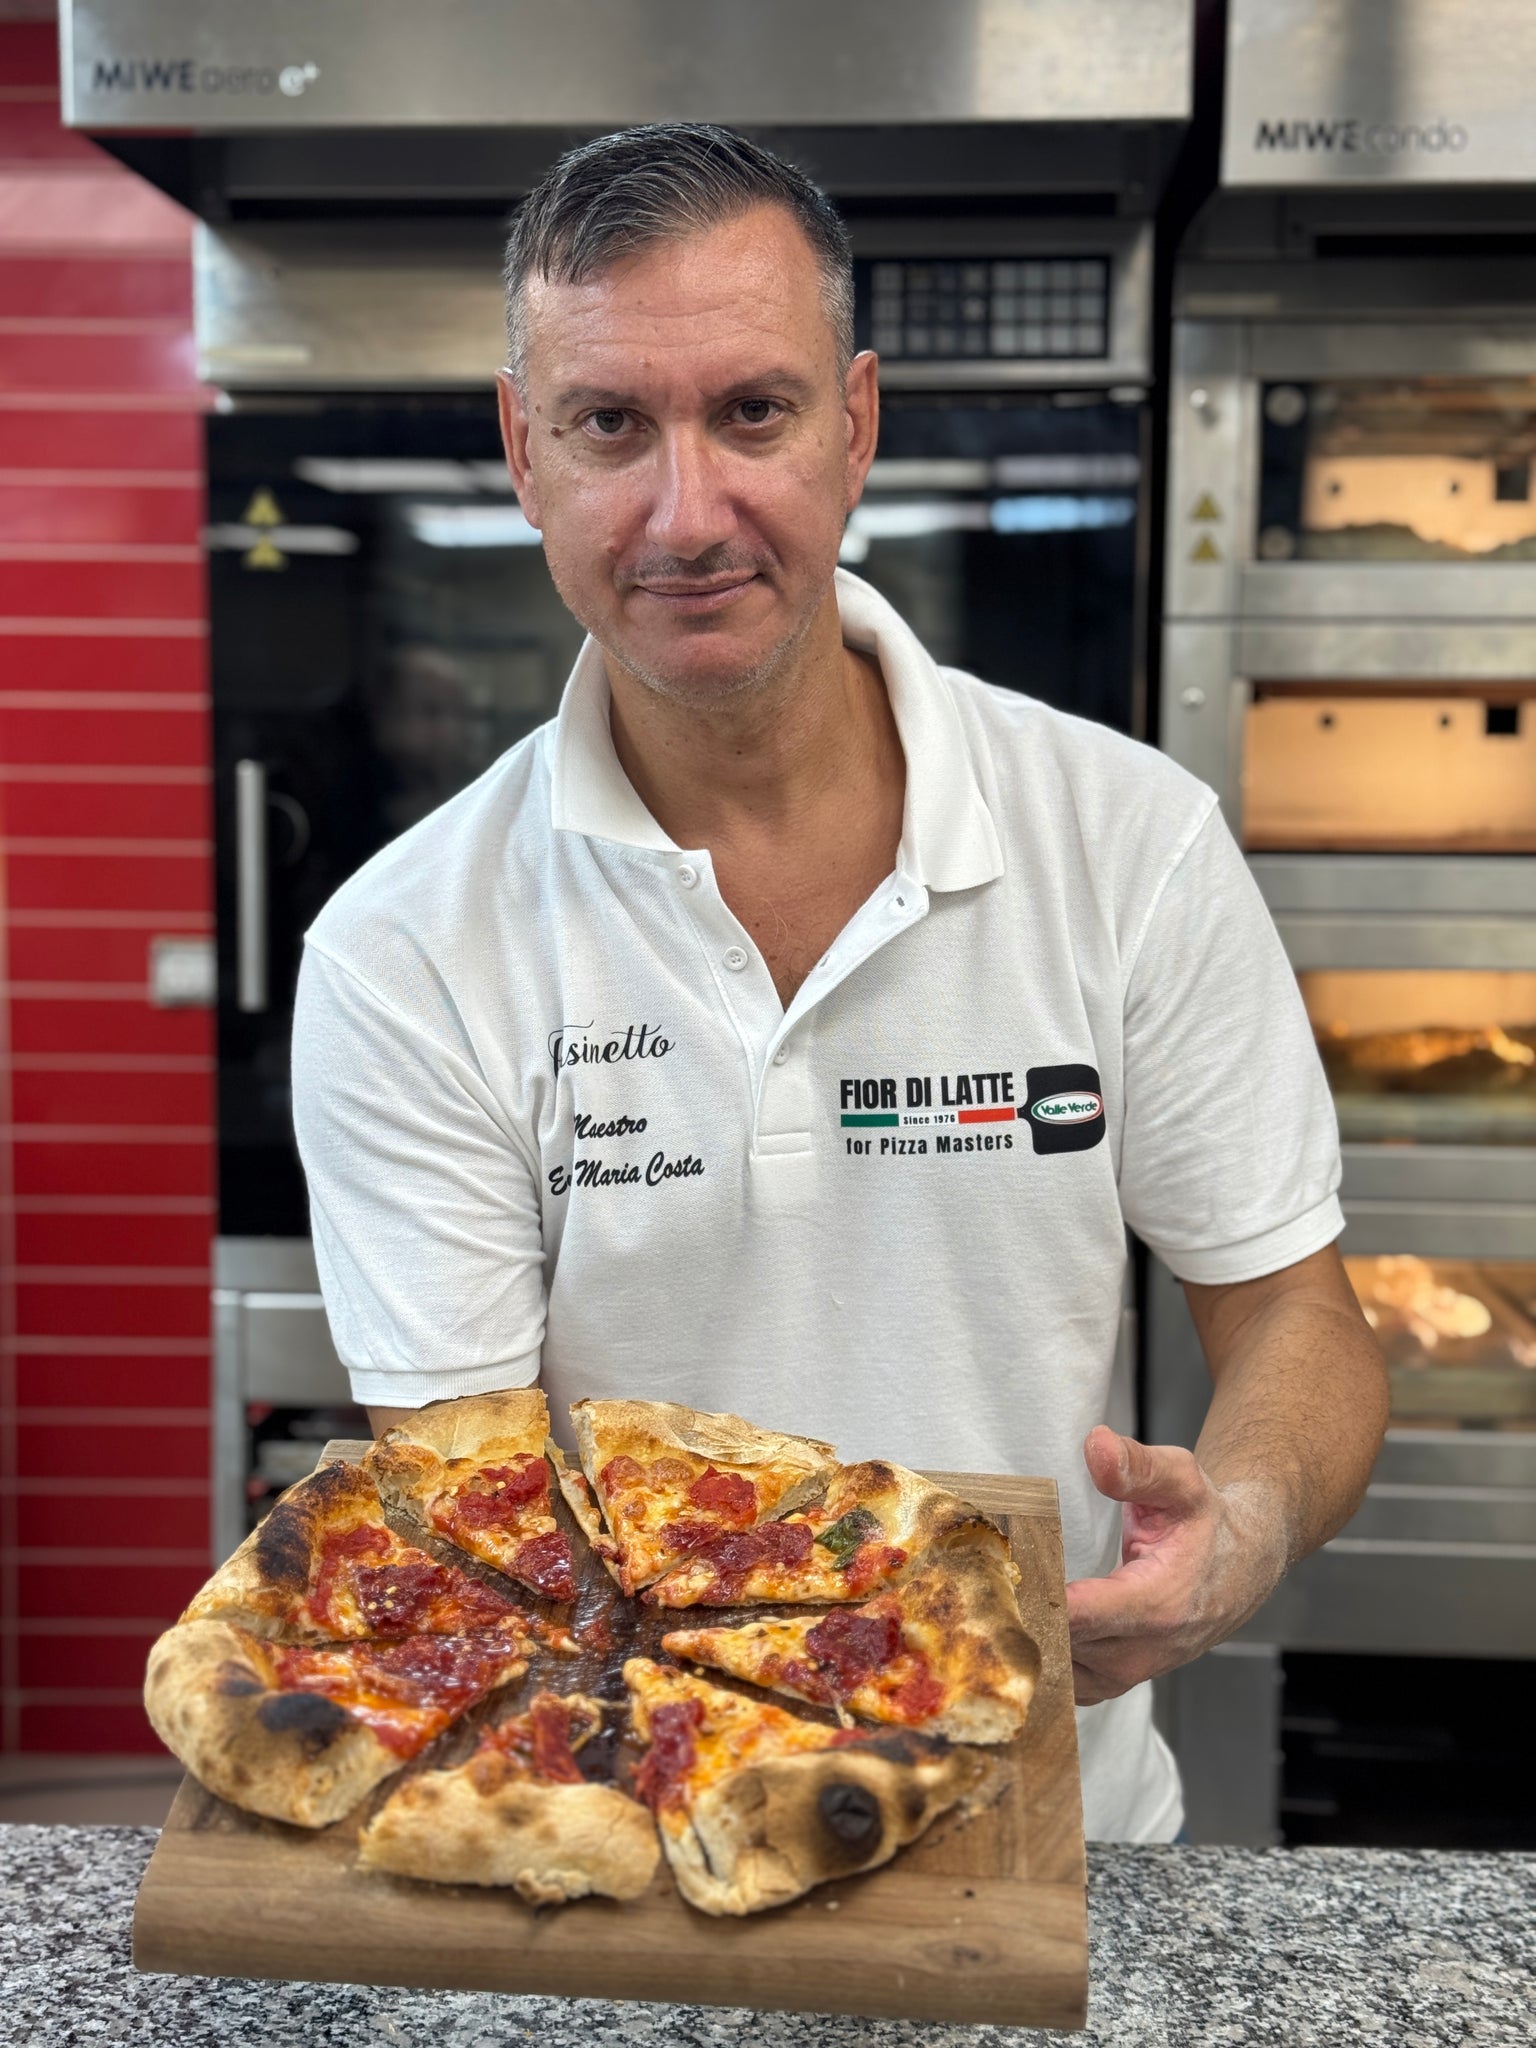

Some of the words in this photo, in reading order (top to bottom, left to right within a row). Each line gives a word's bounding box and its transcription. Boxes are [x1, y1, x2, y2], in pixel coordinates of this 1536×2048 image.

[93, 60, 196, 93] MIWE
[1254, 120, 1358, 151] MIWE
[1363, 118, 1469, 153] condo
[839, 1078, 897, 1110] FIOR
[905, 1076, 932, 1107] DI
[940, 1071, 1015, 1106] LATTE
[903, 1115, 930, 1125] Since
[934, 1113, 956, 1124] 1976
[1041, 1104, 1067, 1115] Valle
[1067, 1101, 1098, 1113] Verde
[845, 1137, 872, 1155] for
[880, 1136, 927, 1155] Pizza
[936, 1134, 1014, 1153] Masters
[574, 1159, 642, 1188] Maria
[645, 1151, 705, 1187] Costa
